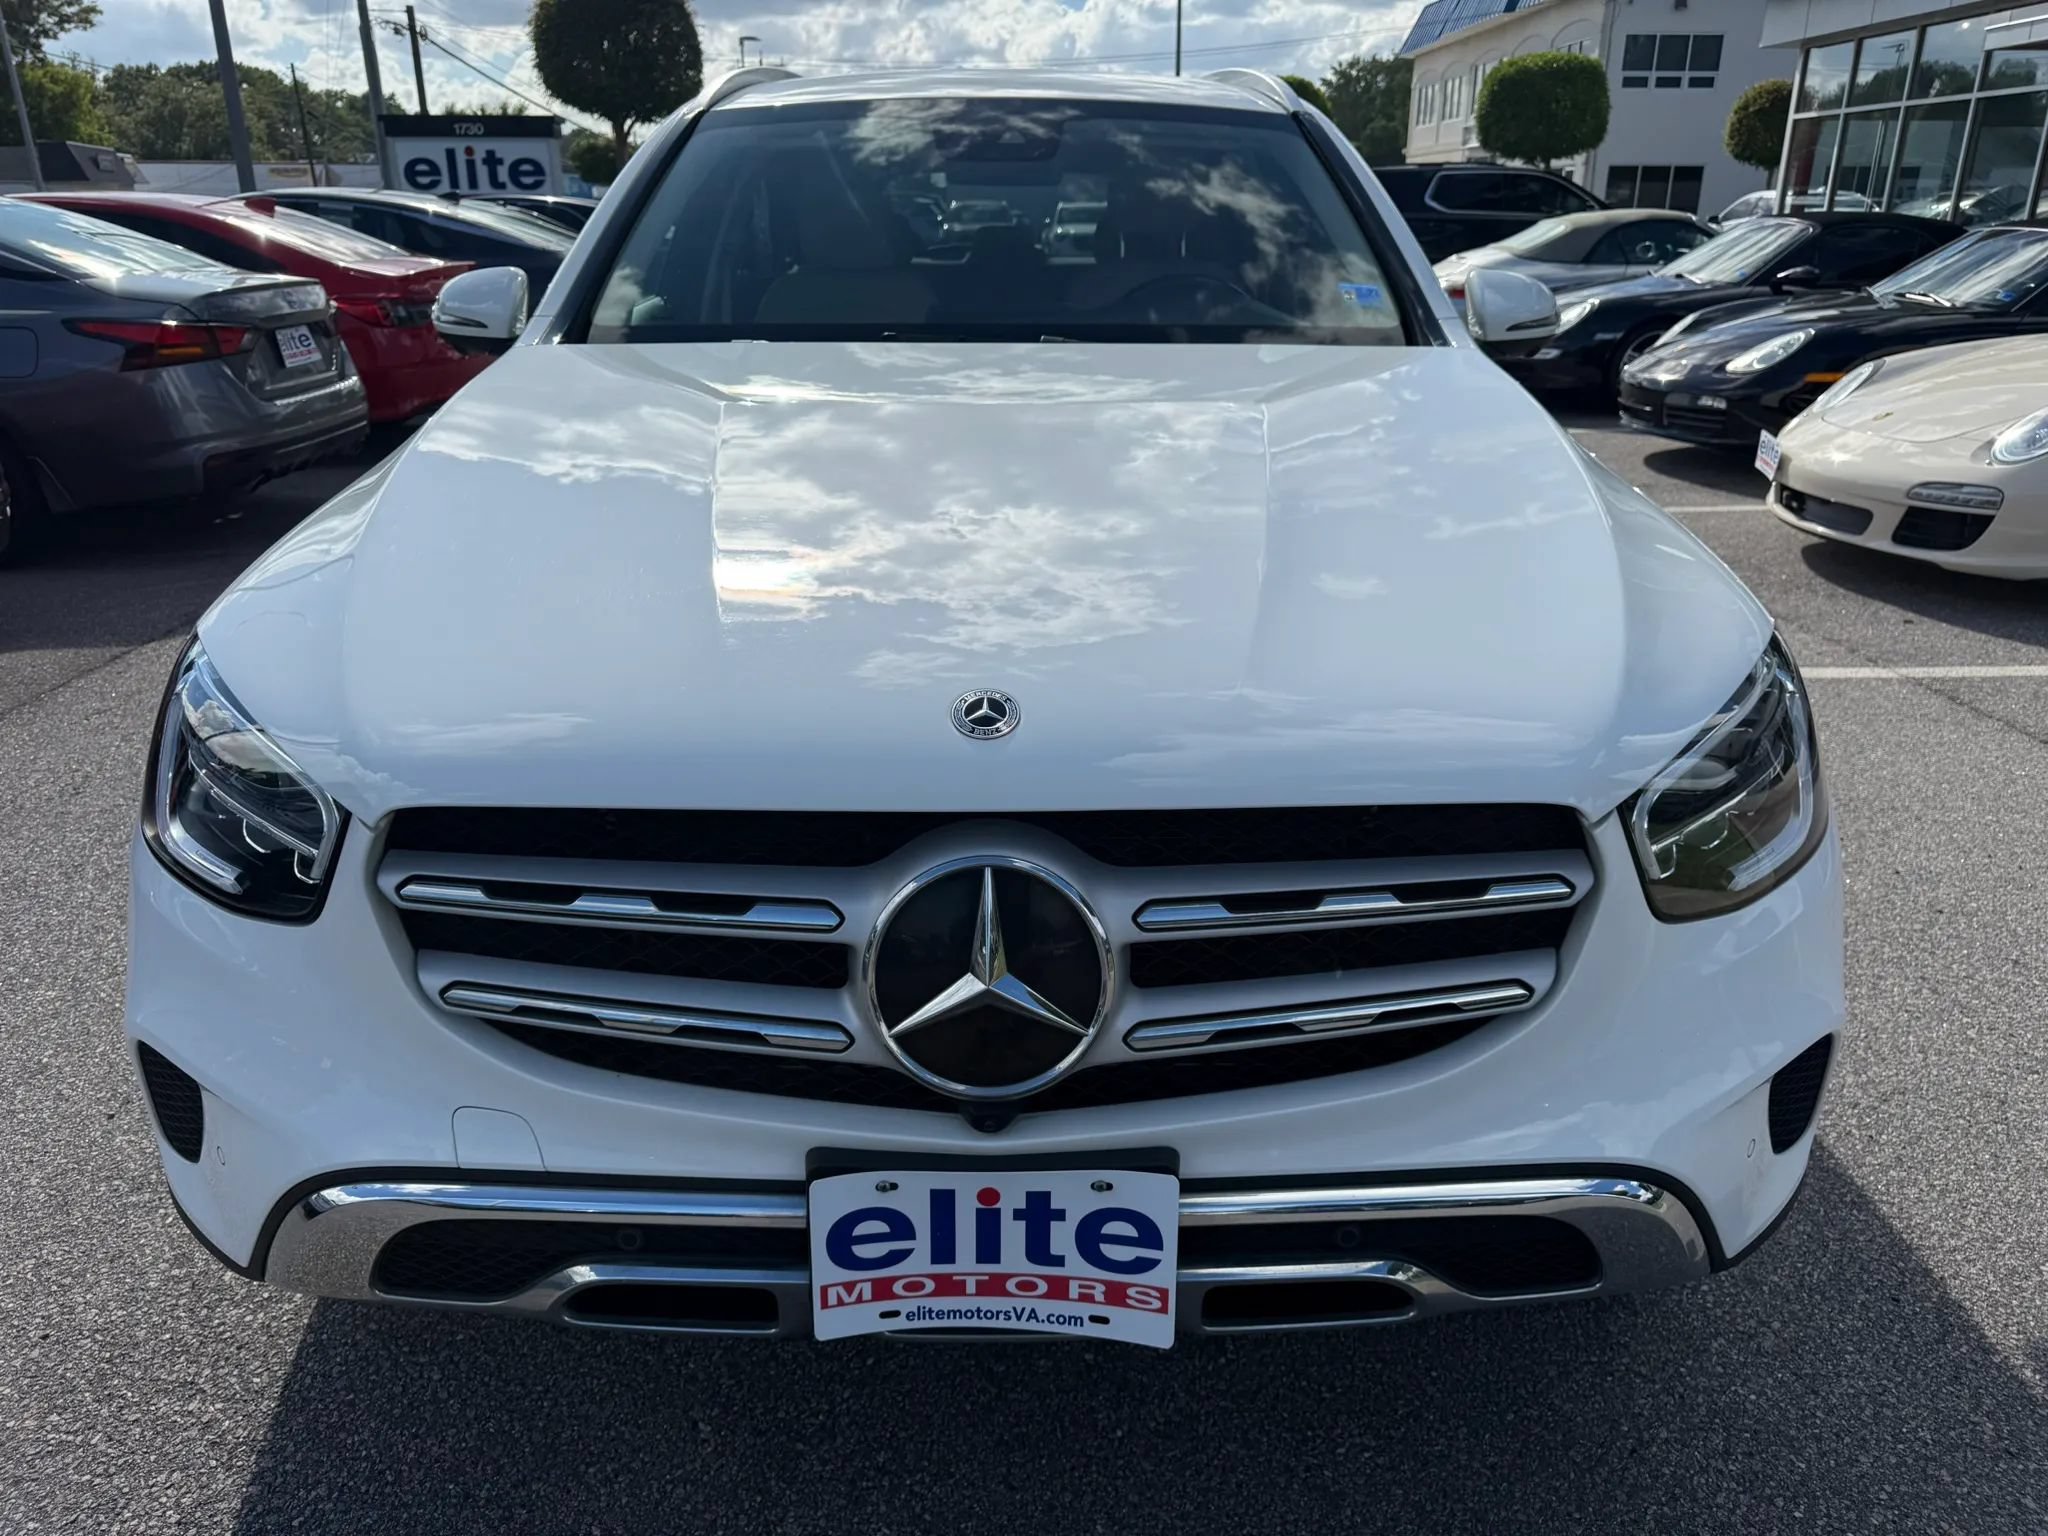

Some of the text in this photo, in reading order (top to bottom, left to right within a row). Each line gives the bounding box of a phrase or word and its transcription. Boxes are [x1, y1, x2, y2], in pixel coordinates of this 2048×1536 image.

[453, 123, 485, 136] 1730
[403, 145, 547, 191] elite
[973, 728, 998, 736] BENZ
[825, 1187, 1164, 1275] elite
[827, 1275, 1163, 1311] MOTORS
[905, 1305, 1085, 1328] elitemotorsVA.com
